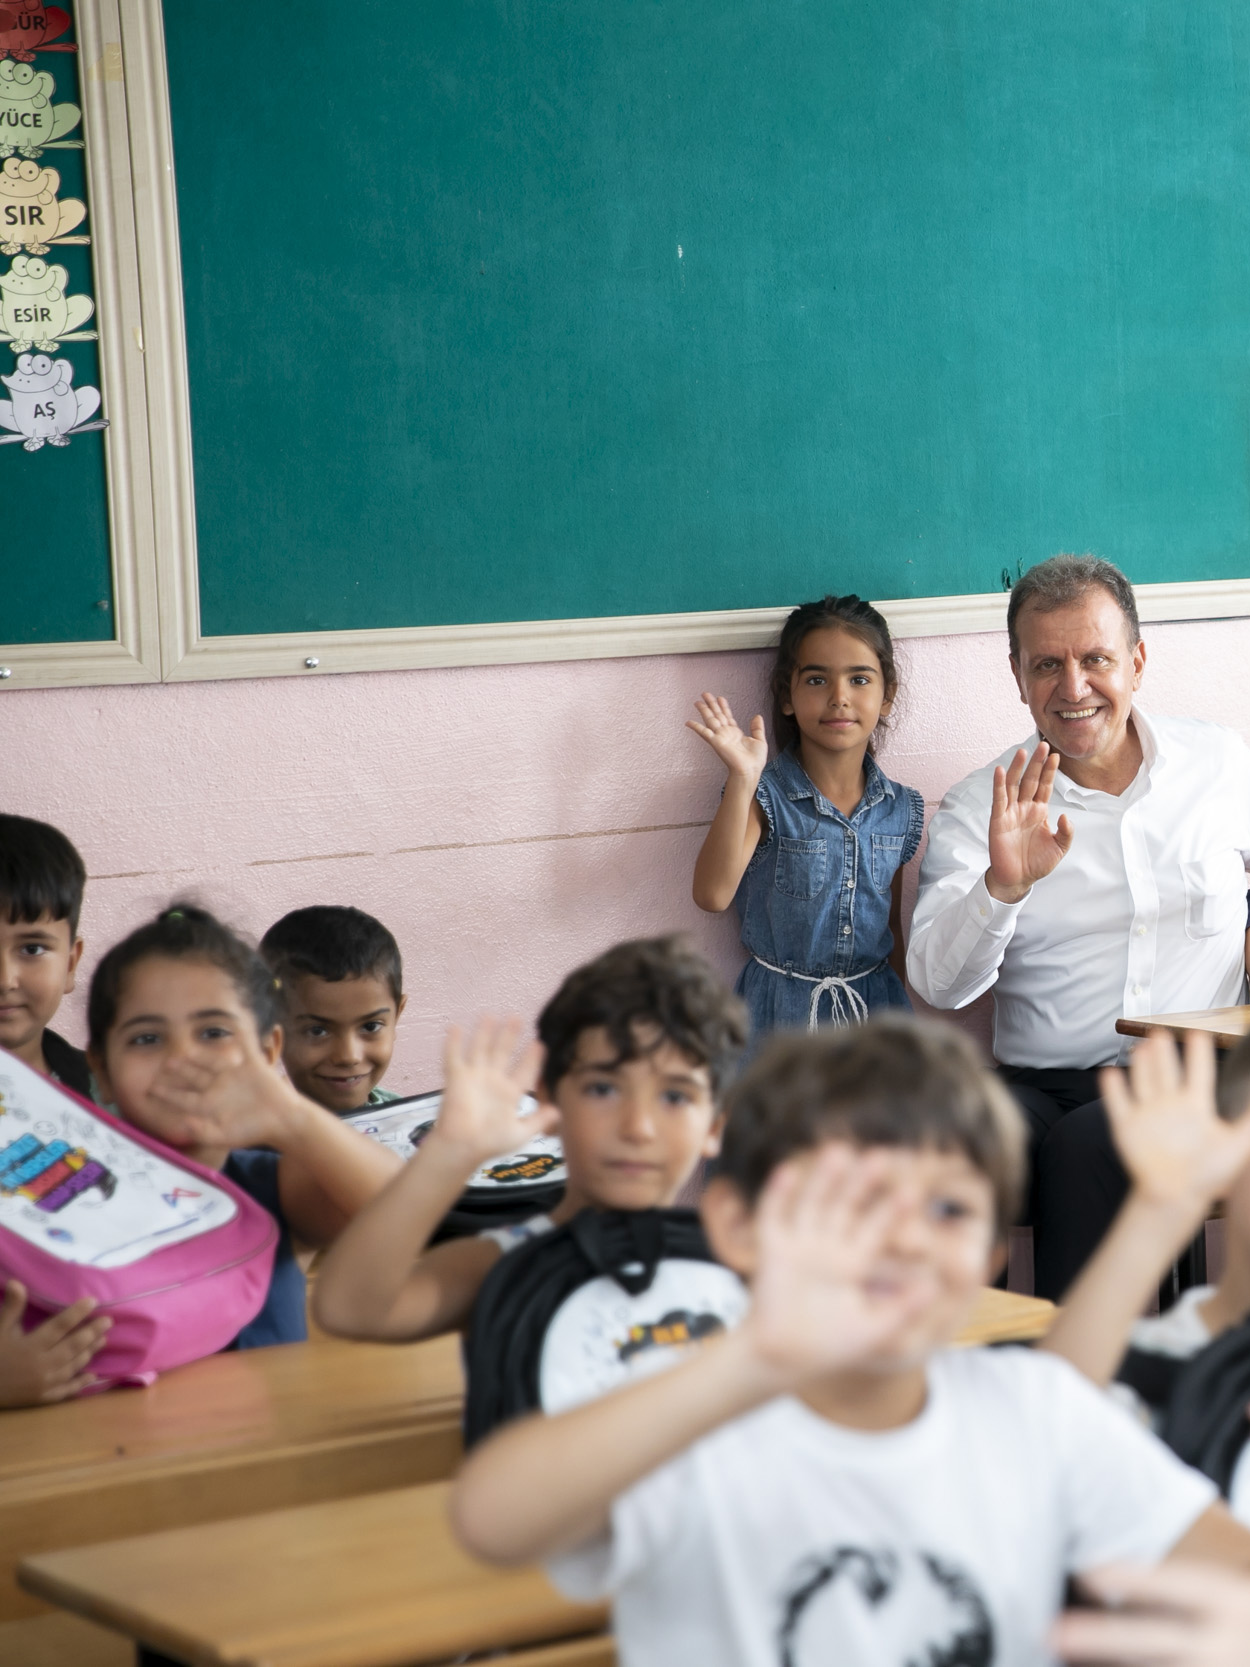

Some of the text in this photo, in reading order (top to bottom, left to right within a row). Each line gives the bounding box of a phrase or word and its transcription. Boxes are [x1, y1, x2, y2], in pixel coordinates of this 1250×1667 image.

[11, 11, 46, 31] ÜR
[4, 204, 45, 227] SIR
[13, 304, 53, 323] ESİR
[33, 401, 57, 421] AŞ
